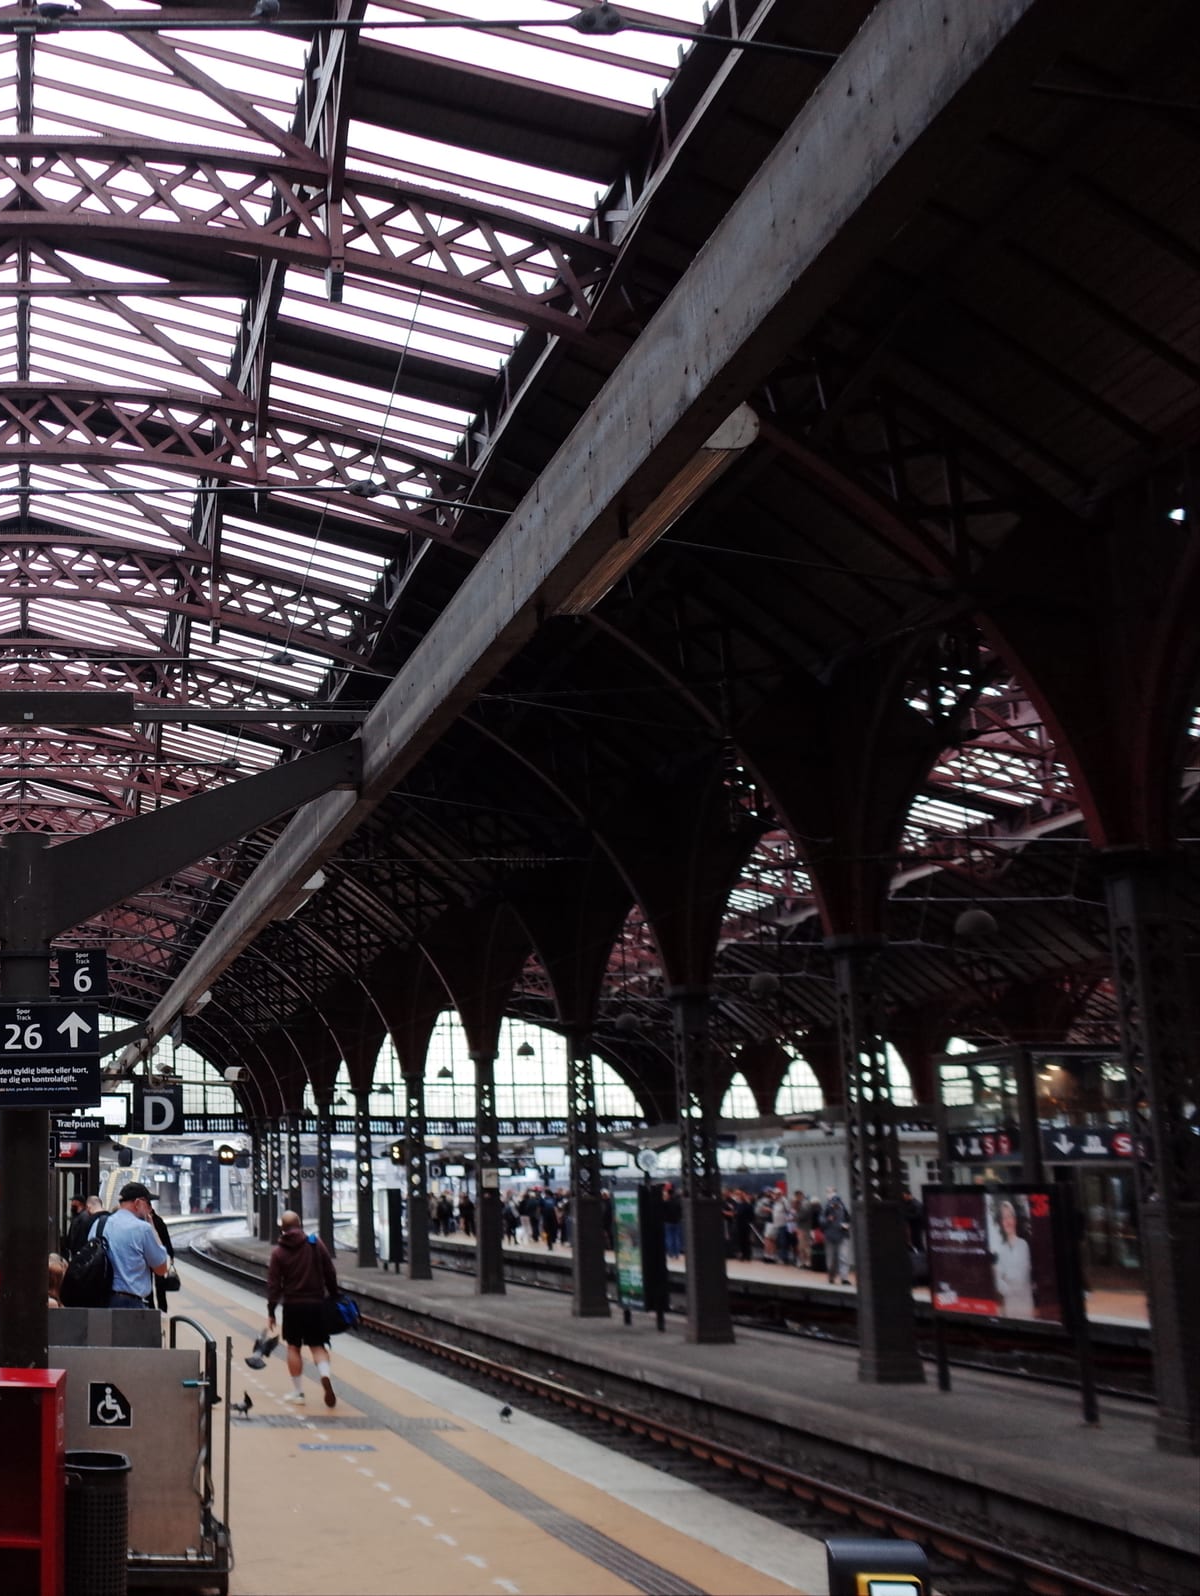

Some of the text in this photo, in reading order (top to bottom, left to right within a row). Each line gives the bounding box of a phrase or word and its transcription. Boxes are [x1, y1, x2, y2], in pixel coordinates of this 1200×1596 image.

[73, 967, 92, 992] 6
[4, 1024, 42, 1049] 26
[13, 1067, 35, 1075] gyldig
[72, 1066, 89, 1074] kort,
[8, 1076, 21, 1084] dig
[31, 1075, 78, 1084] kontrolafgift.
[143, 1095, 175, 1131] D
[56, 1119, 100, 1129] Træfpunkt
